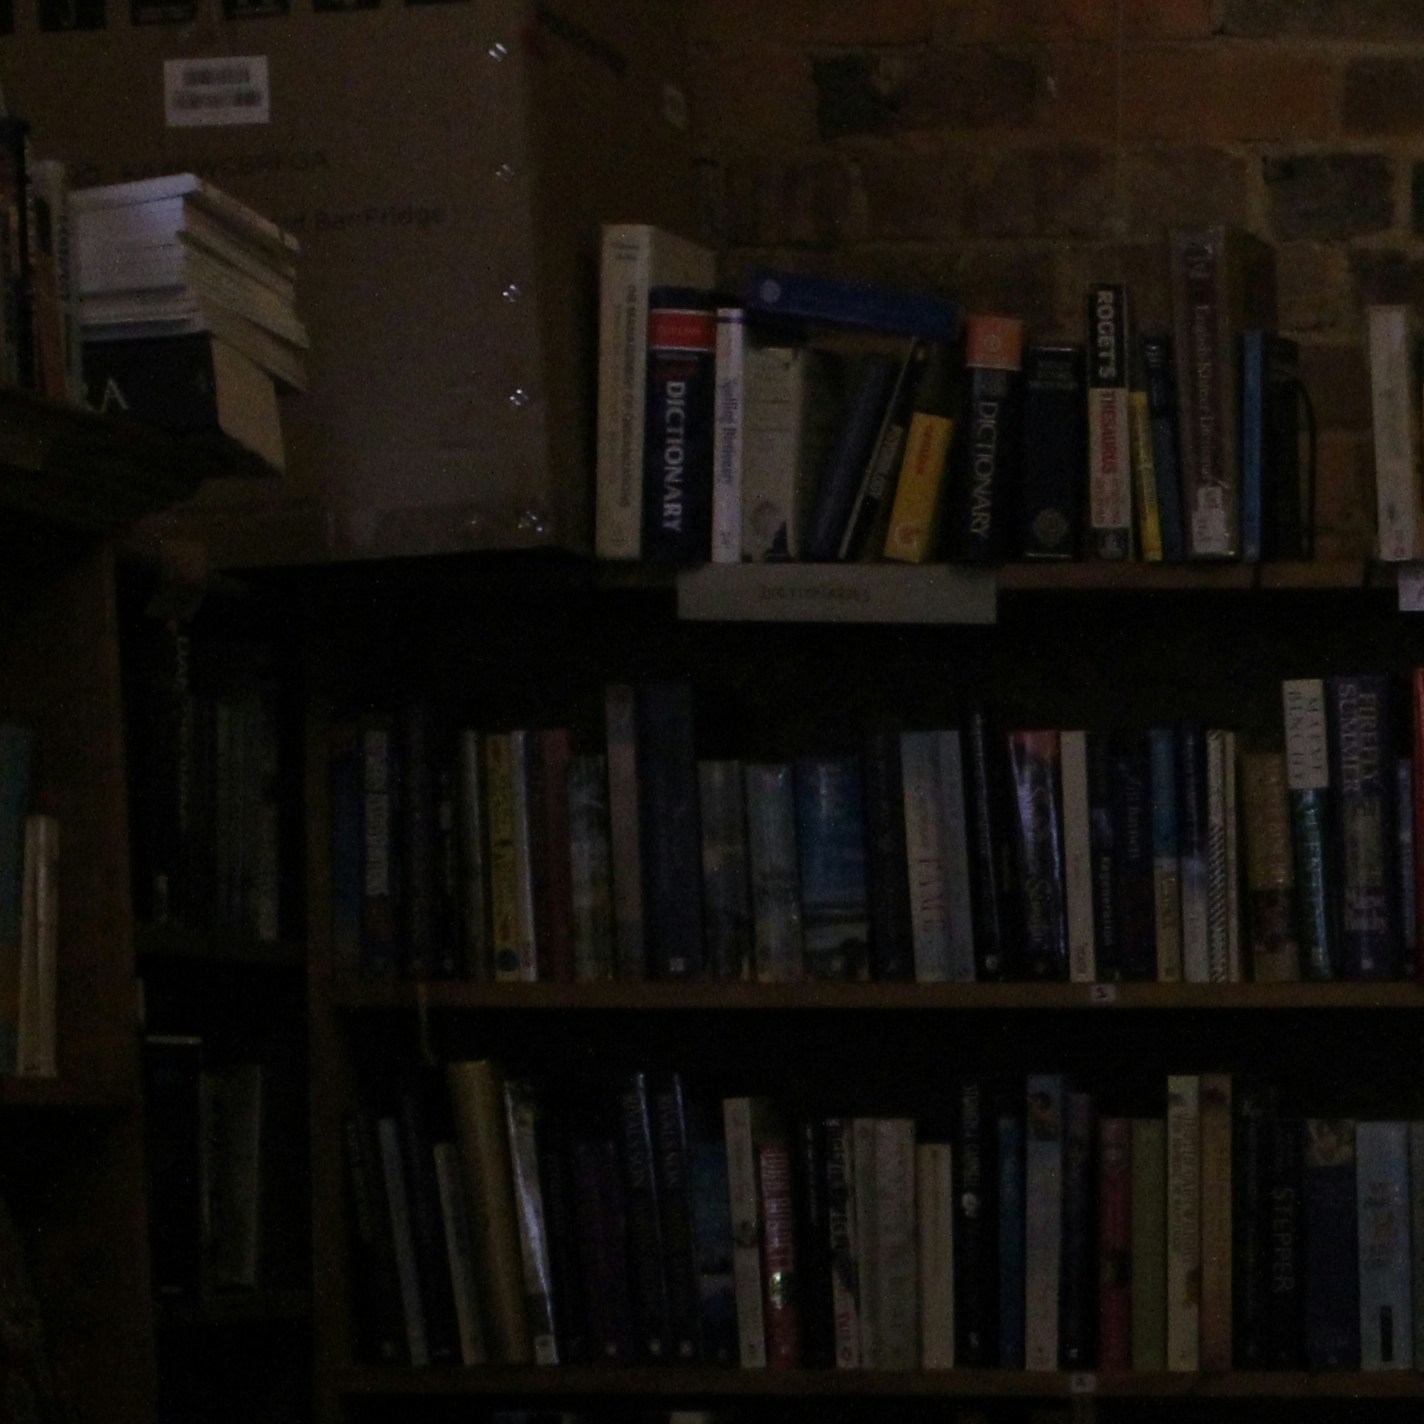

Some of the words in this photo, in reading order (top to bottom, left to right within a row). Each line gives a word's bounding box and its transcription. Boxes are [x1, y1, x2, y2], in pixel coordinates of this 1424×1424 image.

[1096, 290, 1116, 379] ROGET'S
[661, 380, 688, 534] DICTIONARY
[969, 400, 1000, 539] DICTIONARY
[1100, 391, 1118, 475] THESAURUS
[1271, 1185, 1296, 1294] STEPPER
